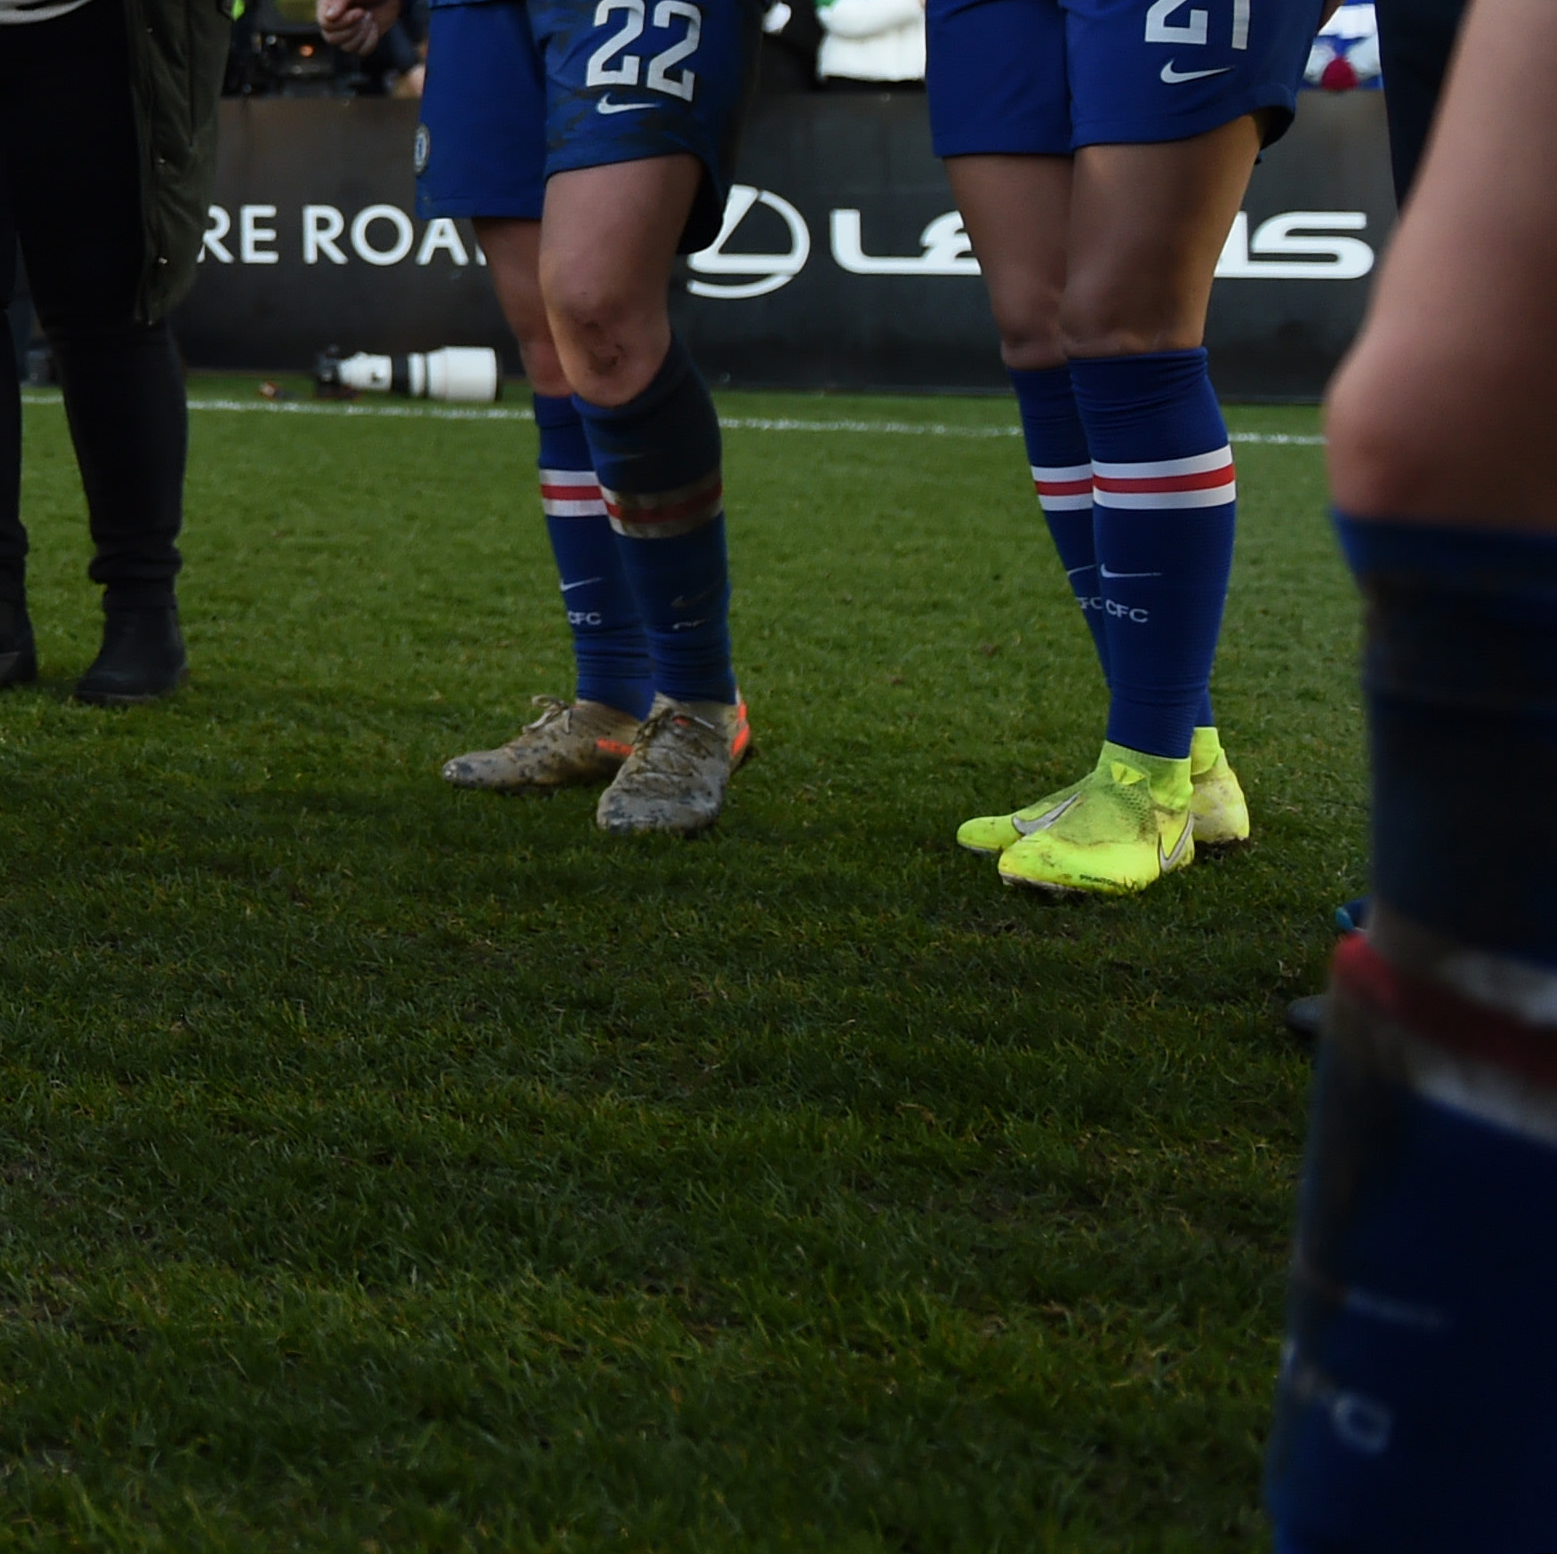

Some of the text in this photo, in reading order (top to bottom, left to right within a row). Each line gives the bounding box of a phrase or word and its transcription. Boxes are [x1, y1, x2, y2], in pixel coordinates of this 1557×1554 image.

[303, 204, 487, 266] ROA
[567, 610, 602, 626] CFC
[1105, 598, 1149, 624] CFC
